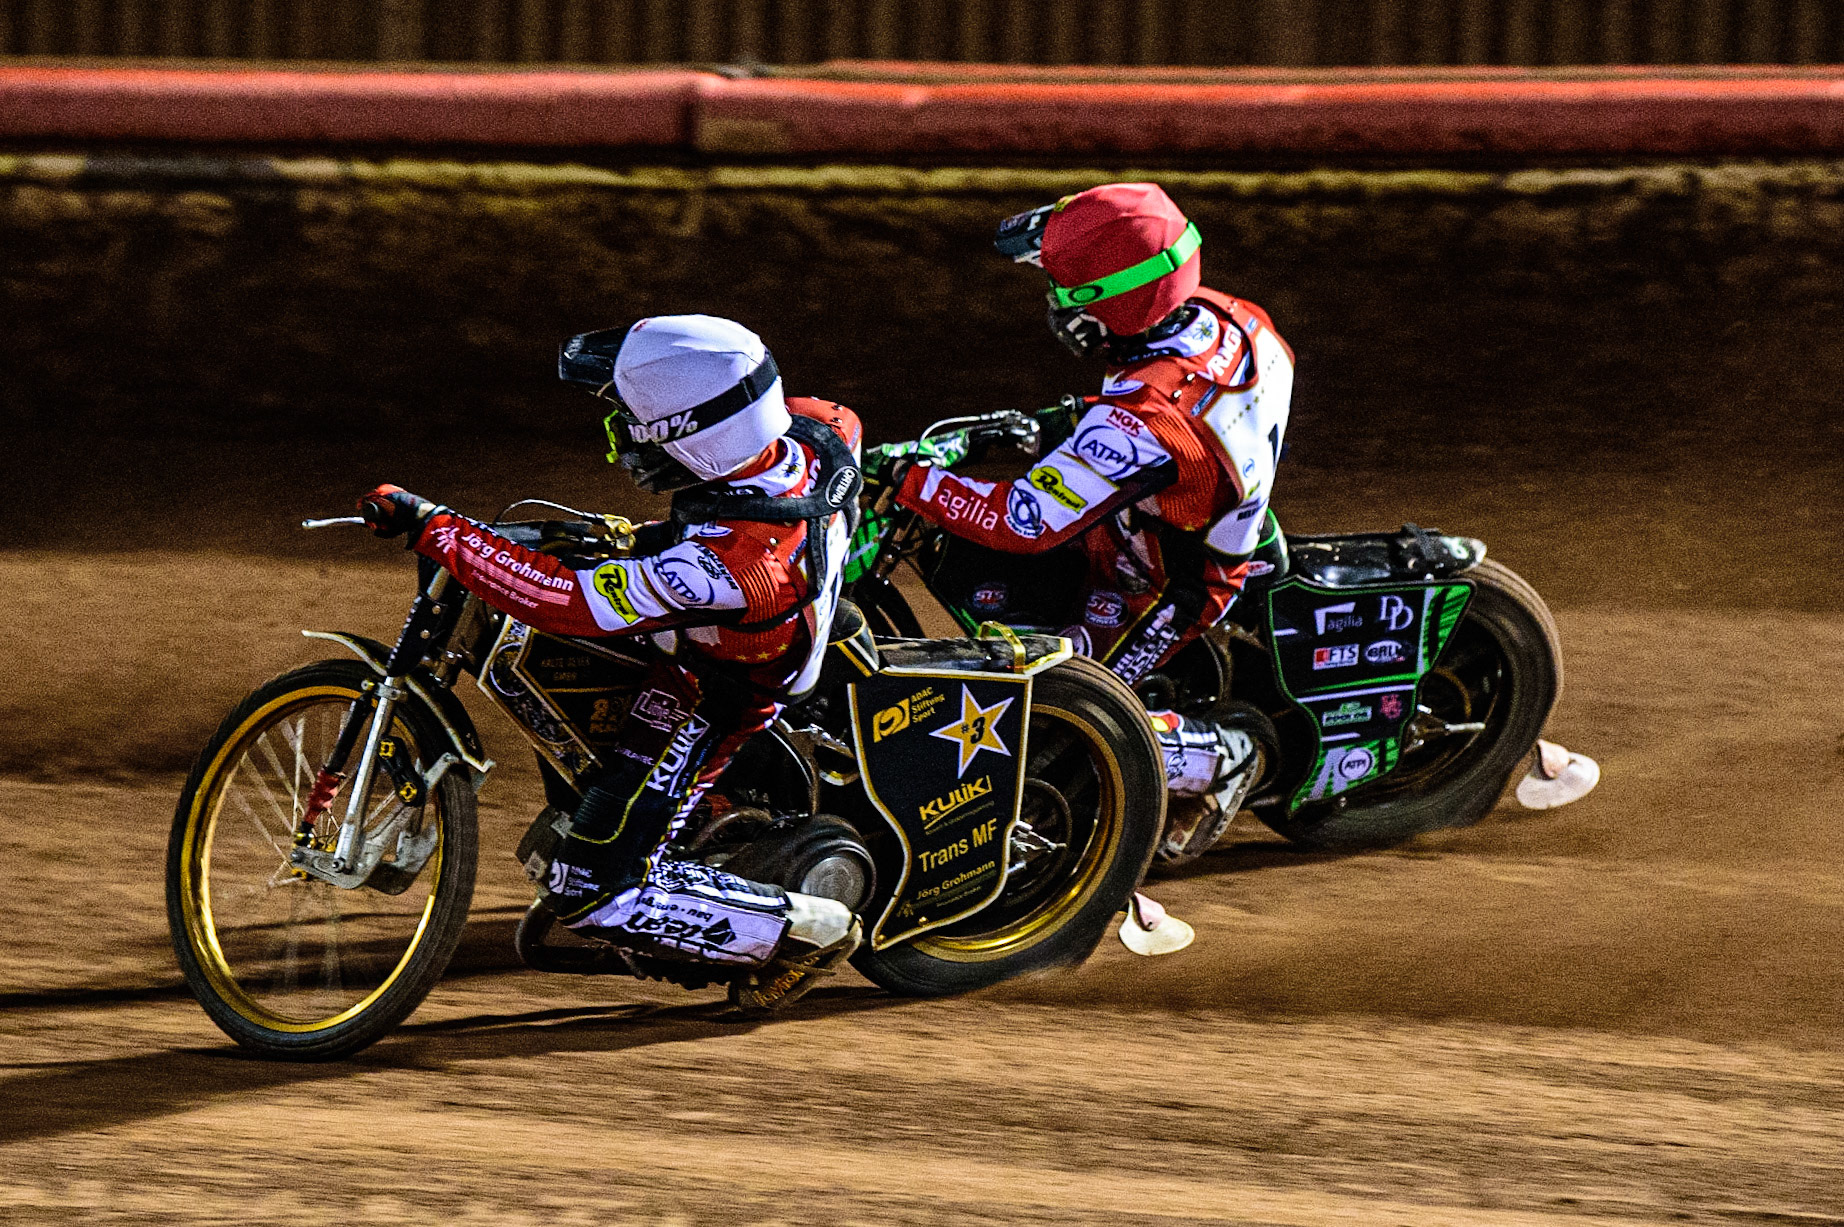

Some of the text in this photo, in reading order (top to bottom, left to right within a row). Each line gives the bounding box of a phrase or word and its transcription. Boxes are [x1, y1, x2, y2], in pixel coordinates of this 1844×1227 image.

[628, 410, 699, 443] 100%
[1108, 407, 1146, 435] NGK
[831, 468, 856, 503] ORTEMA
[938, 488, 999, 531] agilia
[461, 532, 574, 591] Jörg Grohmann
[1327, 615, 1363, 633] agilia
[911, 687, 933, 703] ADAC
[911, 693, 945, 713] Stiftung
[912, 707, 936, 723] Sport
[918, 838, 969, 872] Trans
[971, 818, 998, 848] MF
[917, 882, 941, 900] Jörg
[941, 860, 996, 891] Grohmann
[687, 908, 713, 923] bau
